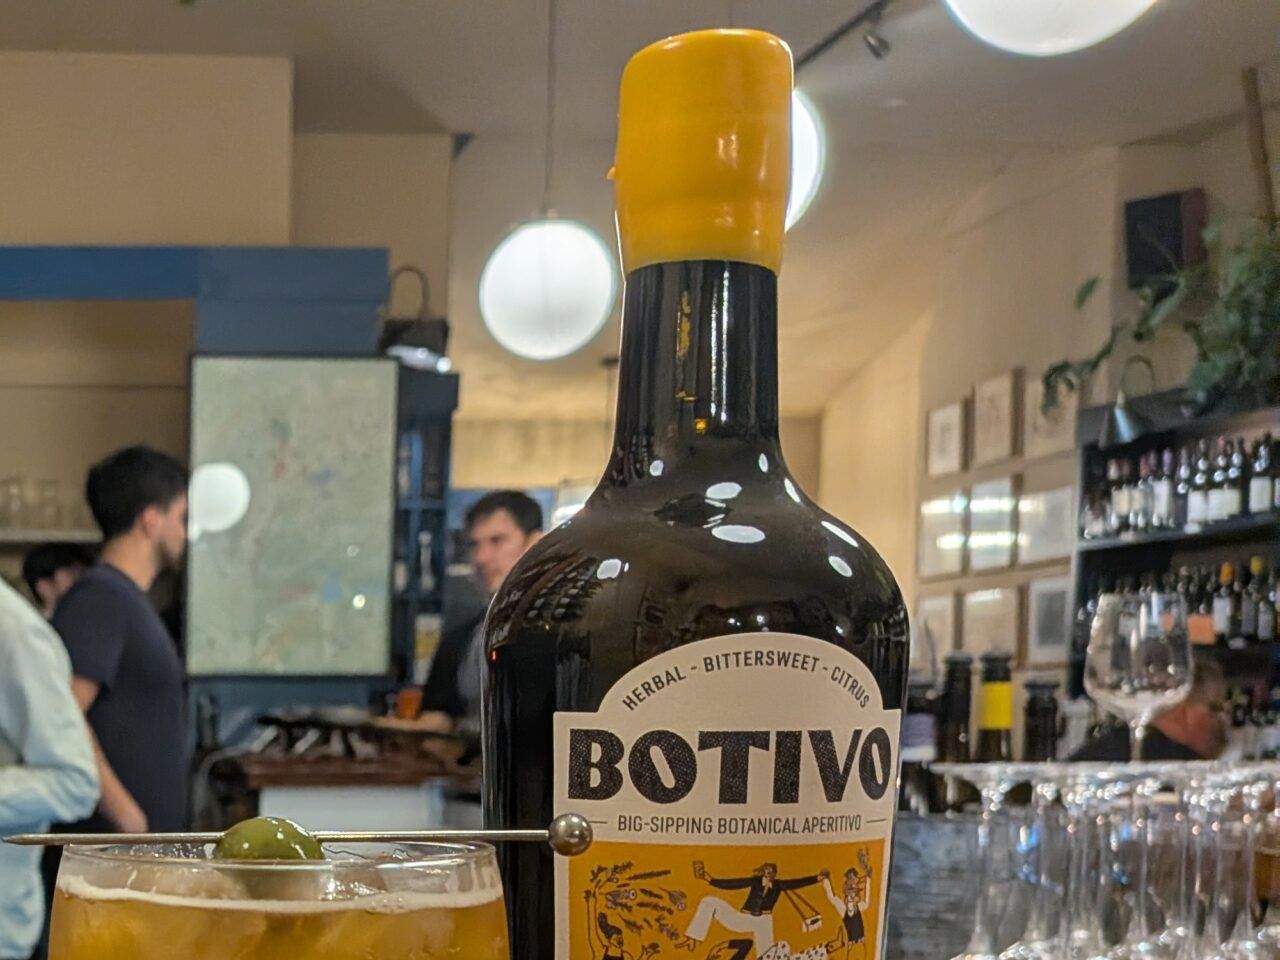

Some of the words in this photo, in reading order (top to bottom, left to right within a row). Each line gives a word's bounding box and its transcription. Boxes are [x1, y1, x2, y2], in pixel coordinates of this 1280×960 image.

[622, 665, 686, 711] HERBAL
[703, 650, 820, 673] BITTERSWEET
[830, 665, 870, 709] CITRUS
[568, 727, 892, 804] BOTIVO
[618, 815, 713, 834] BIG-SIPPING
[718, 815, 799, 834] BOTANICAL
[802, 813, 862, 833] APERITIVO
